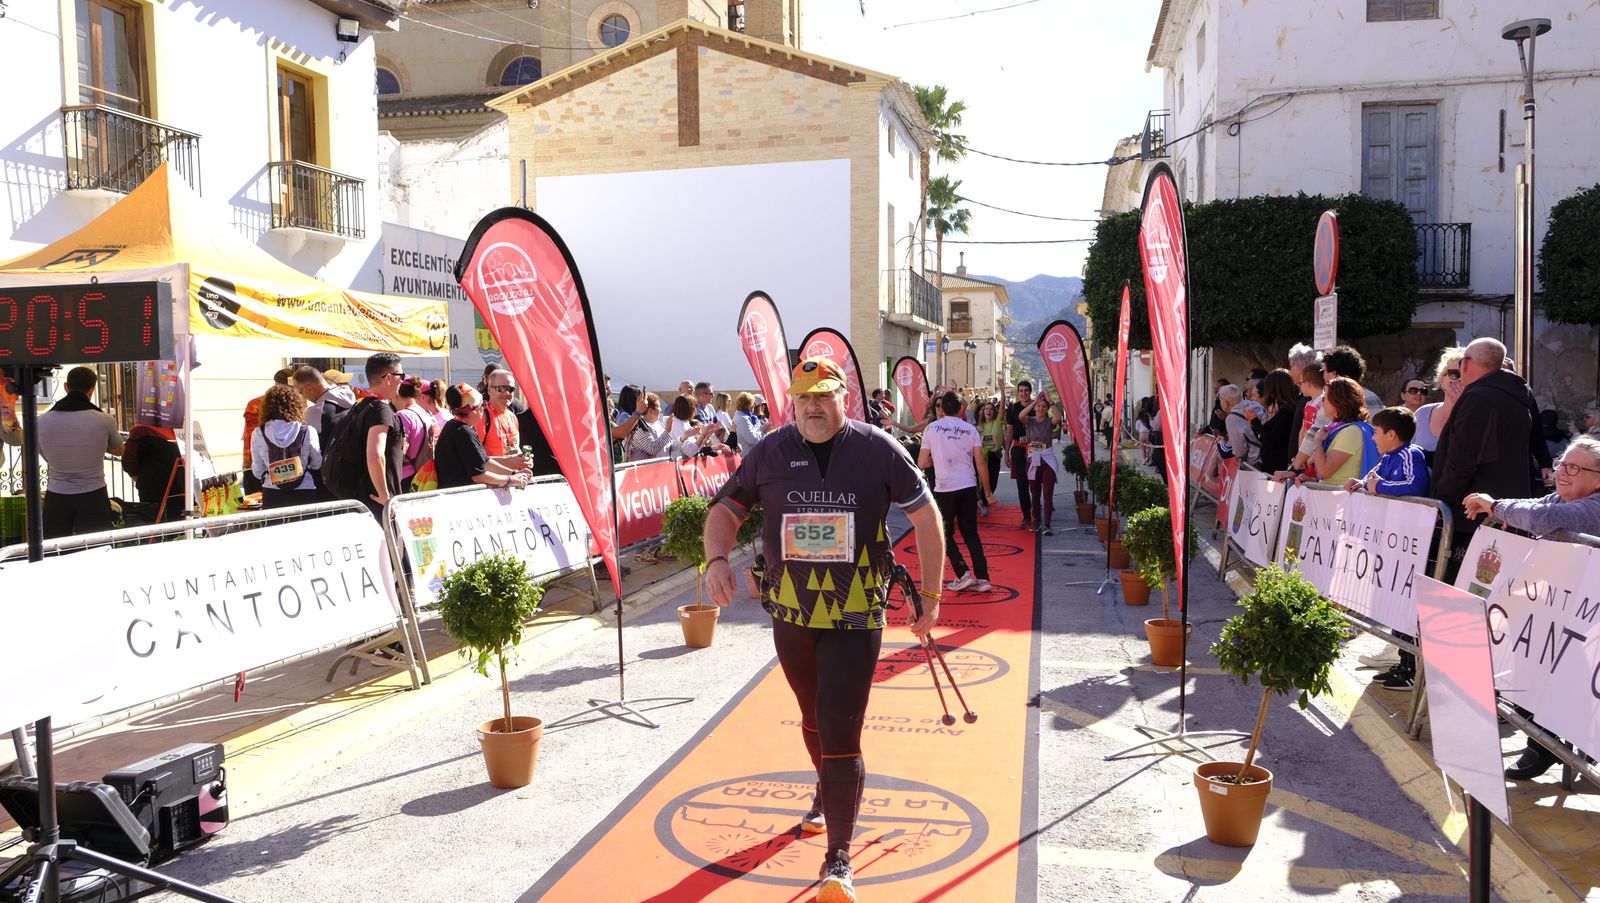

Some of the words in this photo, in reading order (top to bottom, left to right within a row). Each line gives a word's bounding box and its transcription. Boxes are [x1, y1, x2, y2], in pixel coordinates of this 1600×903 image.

[391, 248, 458, 276] EXCELENTÍSI
[393, 276, 468, 301] AYUNTAMIENTO
[274, 463, 296, 474] 439
[617, 485, 672, 523] VEOLIA
[452, 519, 579, 568] CANTORIA
[794, 525, 836, 541] 652
[1402, 535, 1418, 555] DE
[122, 550, 334, 607] AYUNTAMIENTO
[342, 543, 366, 562] DE
[1300, 535, 1416, 599] CANTORIA
[126, 566, 379, 658] CANTORIA
[722, 785, 891, 808] PVORA
[747, 780, 818, 791] antoria
[905, 798, 950, 811] LA
